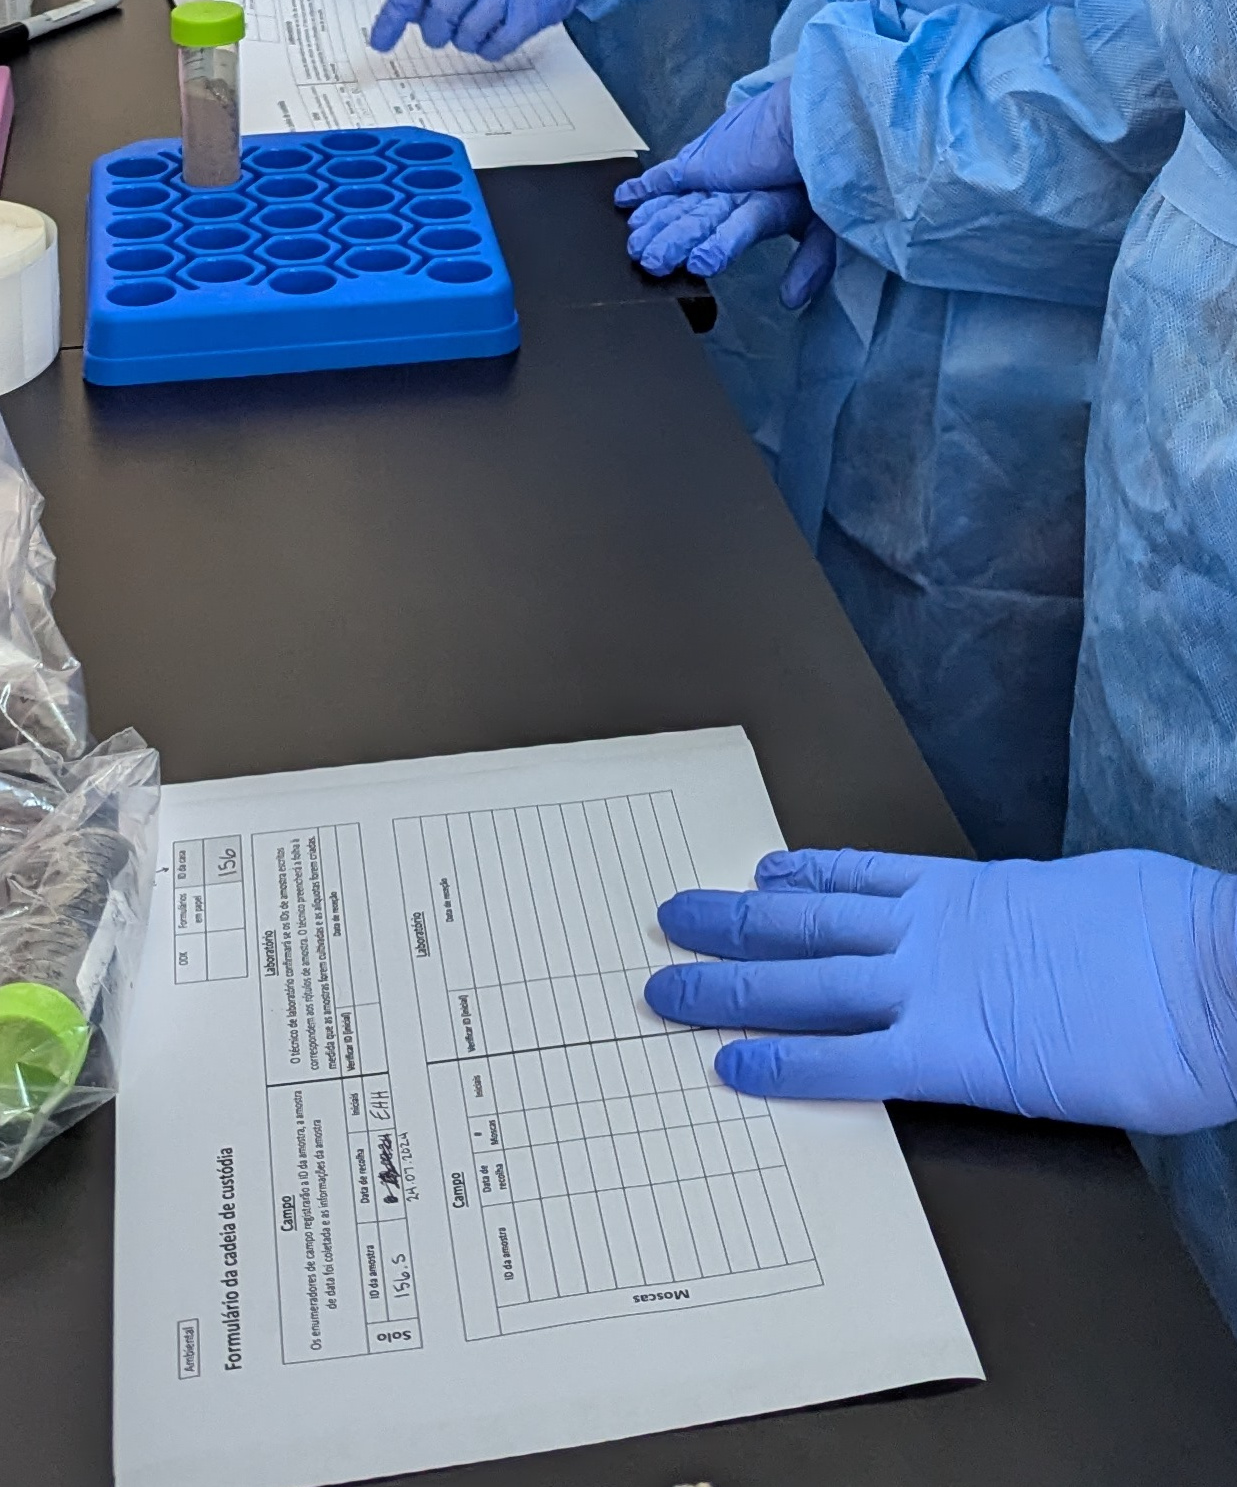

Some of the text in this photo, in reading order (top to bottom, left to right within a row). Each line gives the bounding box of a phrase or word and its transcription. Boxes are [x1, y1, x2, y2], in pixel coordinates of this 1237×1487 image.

[218, 848, 237, 877] 156
[194, 895, 204, 912] papel
[411, 911, 429, 958] Laboratório
[262, 930, 277, 977] Laboratório
[281, 941, 294, 977] confirmará
[284, 979, 297, 1018] laboratório
[287, 1019, 298, 1028] de
[325, 1026, 336, 1040] que
[288, 1030, 300, 1056] técnico
[306, 1018, 319, 1070] correspondem
[325, 1042, 337, 1070] medida
[294, 1090, 304, 1119] amostra
[313, 1120, 323, 1148] amostra
[489, 1120, 499, 1146] Moscas
[297, 1160, 308, 1170] da
[314, 1150, 324, 1159] da
[398, 1132, 420, 1202] 24.07.2024
[298, 1171, 309, 1179] ID
[315, 1161, 328, 1208] informações
[356, 1149, 370, 1204] Data de recolha
[480, 1165, 492, 1193] Data de
[495, 1164, 508, 1190] recolha
[451, 1172, 468, 1209] Campo
[280, 1195, 296, 1232] Campo
[299, 1188, 314, 1230] registrarão
[321, 1210, 330, 1218] as
[216, 1147, 242, 1371] Formulário da cadeia de custódia
[304, 1232, 316, 1259] campo
[320, 1228, 334, 1262] coletada
[498, 1227, 514, 1280] ID da amostra
[304, 1261, 316, 1272] de
[322, 1264, 334, 1275] foi
[366, 1245, 380, 1299] ID da amostra
[325, 1278, 336, 1296] data
[632, 1289, 691, 1303] Moscas
[307, 1274, 321, 1336] enumeradores
[325, 1299, 337, 1310] de
[182, 1326, 195, 1372] Ambiental
[310, 1339, 322, 1350] Os
[376, 1330, 412, 1344] Solo
